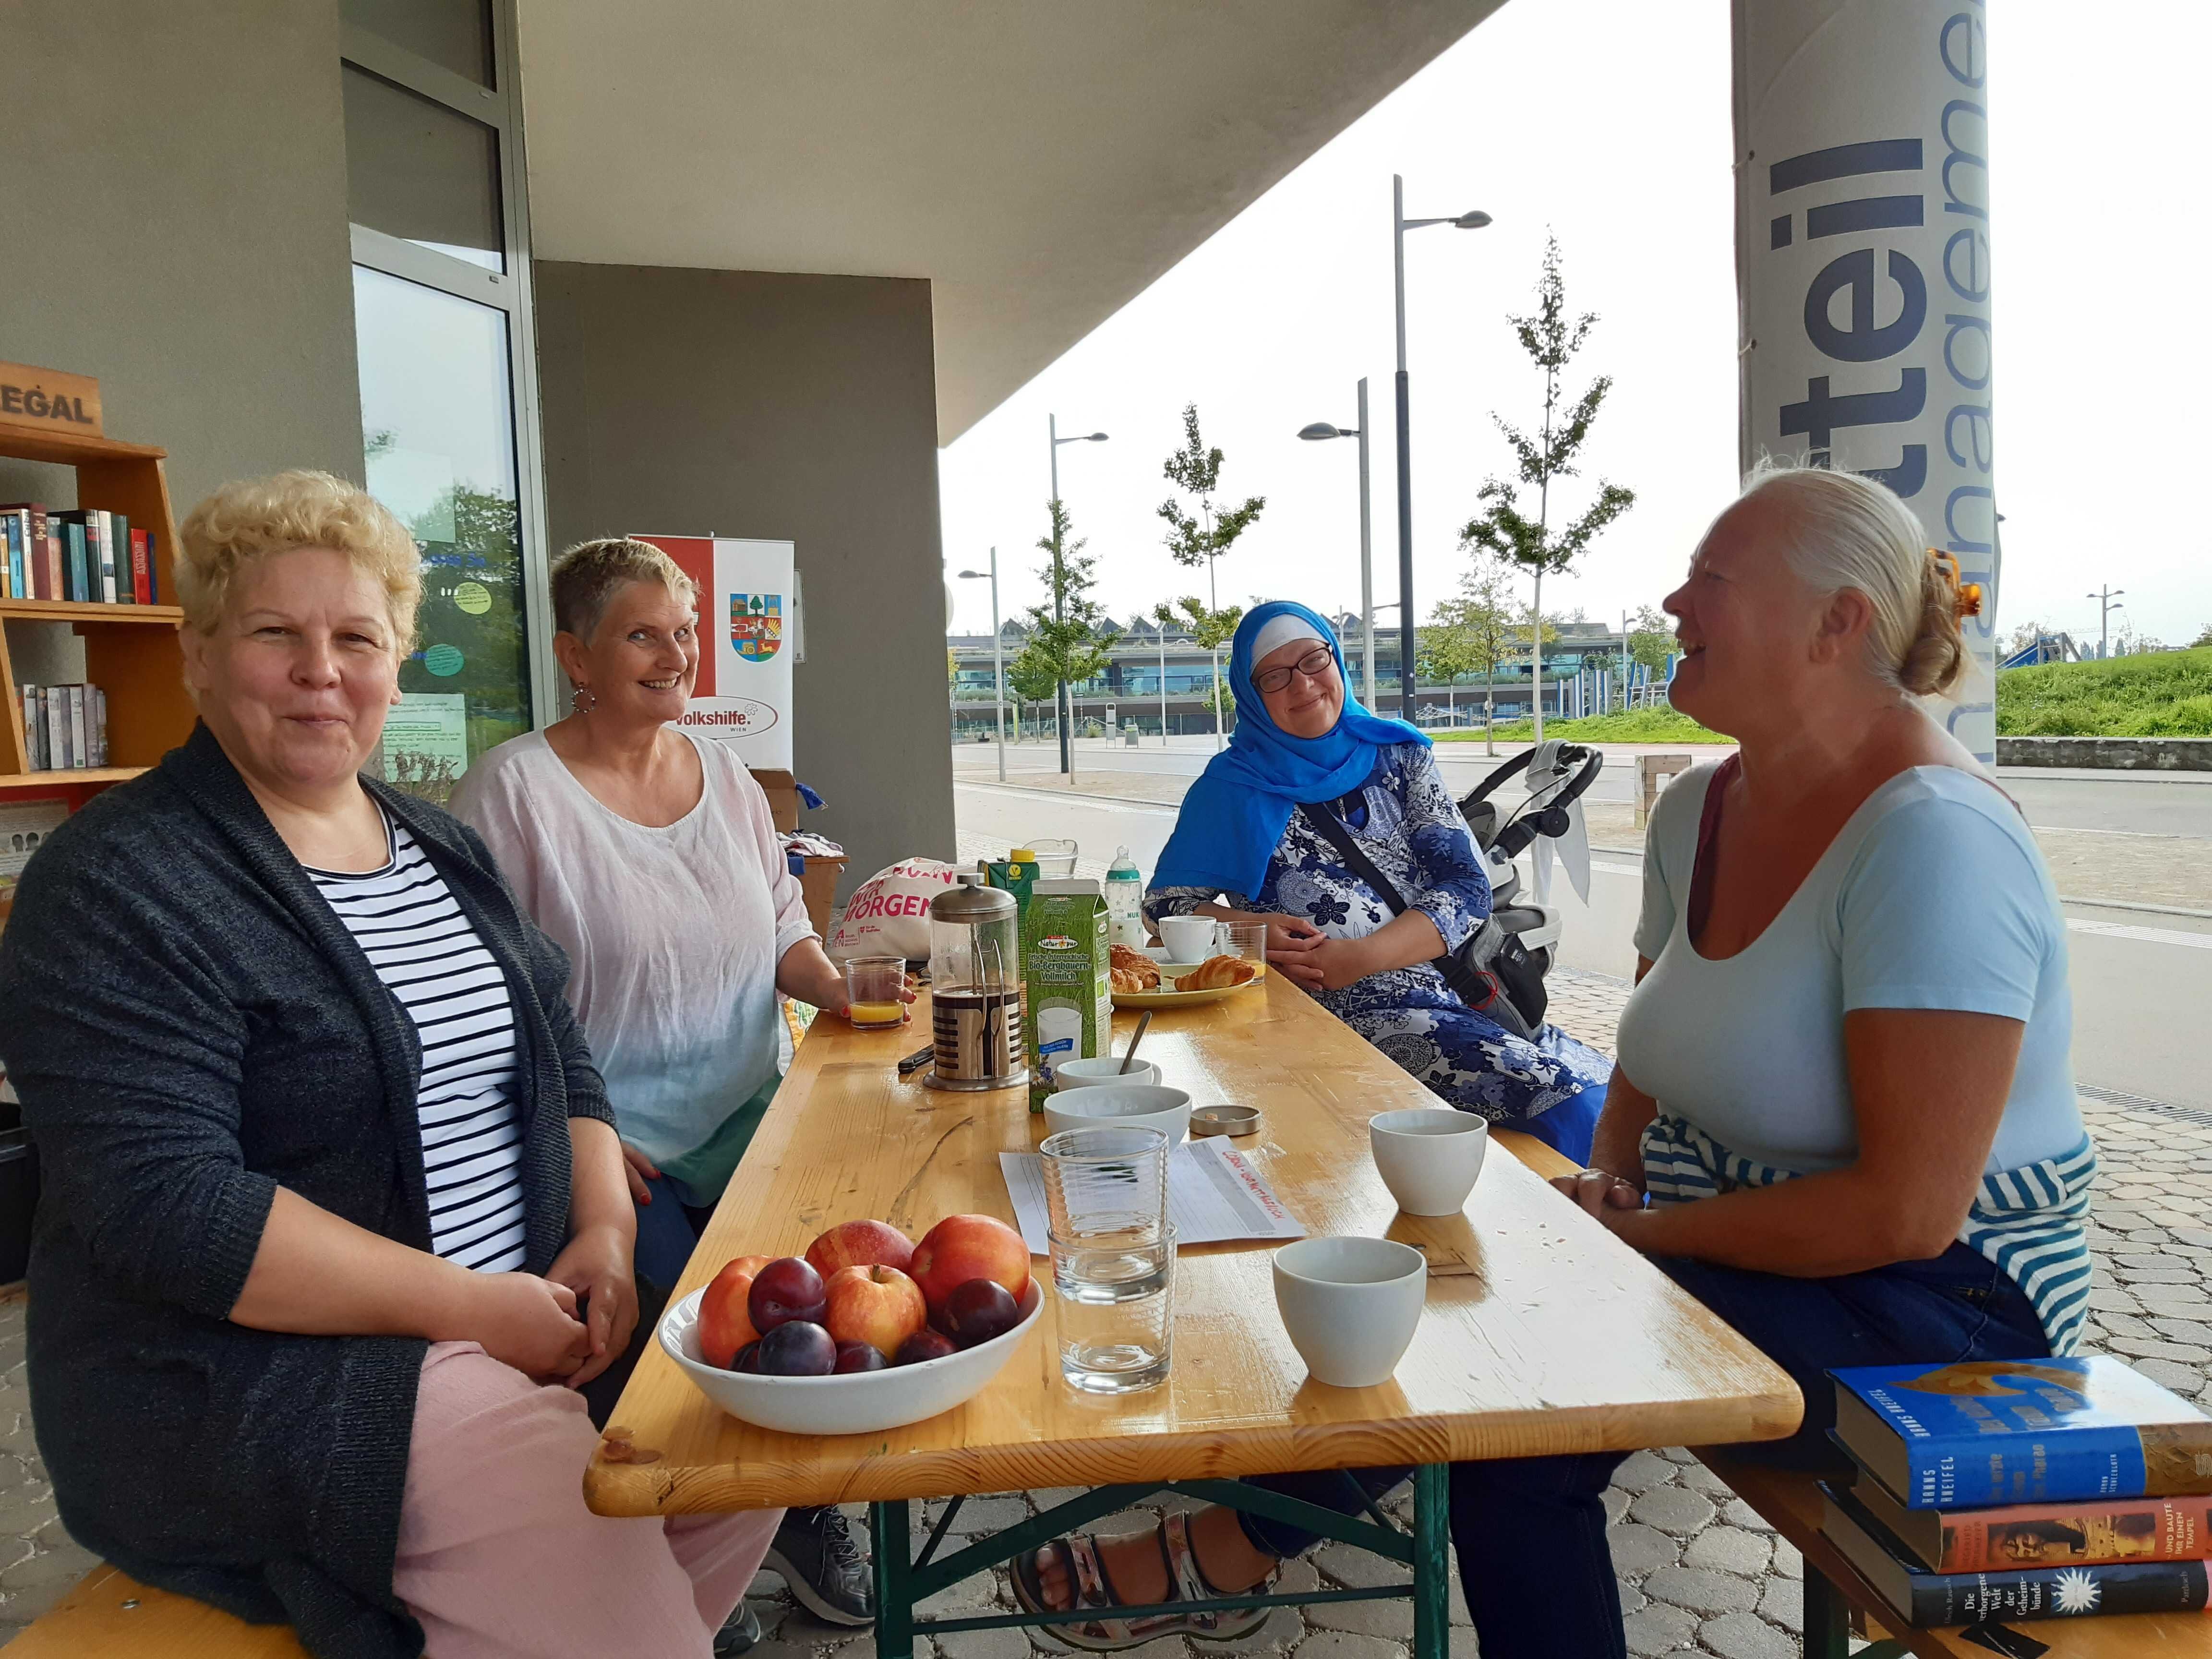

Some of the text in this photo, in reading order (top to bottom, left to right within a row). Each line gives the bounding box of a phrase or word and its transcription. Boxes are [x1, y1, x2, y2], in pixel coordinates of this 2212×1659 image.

[1041, 972, 1076, 980] Vollmilch
[1922, 1469, 1936, 1503] HANNS
[2164, 1503, 2174, 1532] BAUTE
[2165, 1535, 2174, 1553] UND
[2175, 1512, 2184, 1554] IHR EINEN
[2186, 1517, 2194, 1549] TEMPEL
[1964, 1593, 1975, 1610] Die
[1977, 1573, 1991, 1622] verborgene
[1991, 1588, 2002, 1610] Welt
[2004, 1590, 2015, 1606] der
[2016, 1575, 2028, 1616] Geheim-
[2030, 1582, 2041, 1610] bünde
